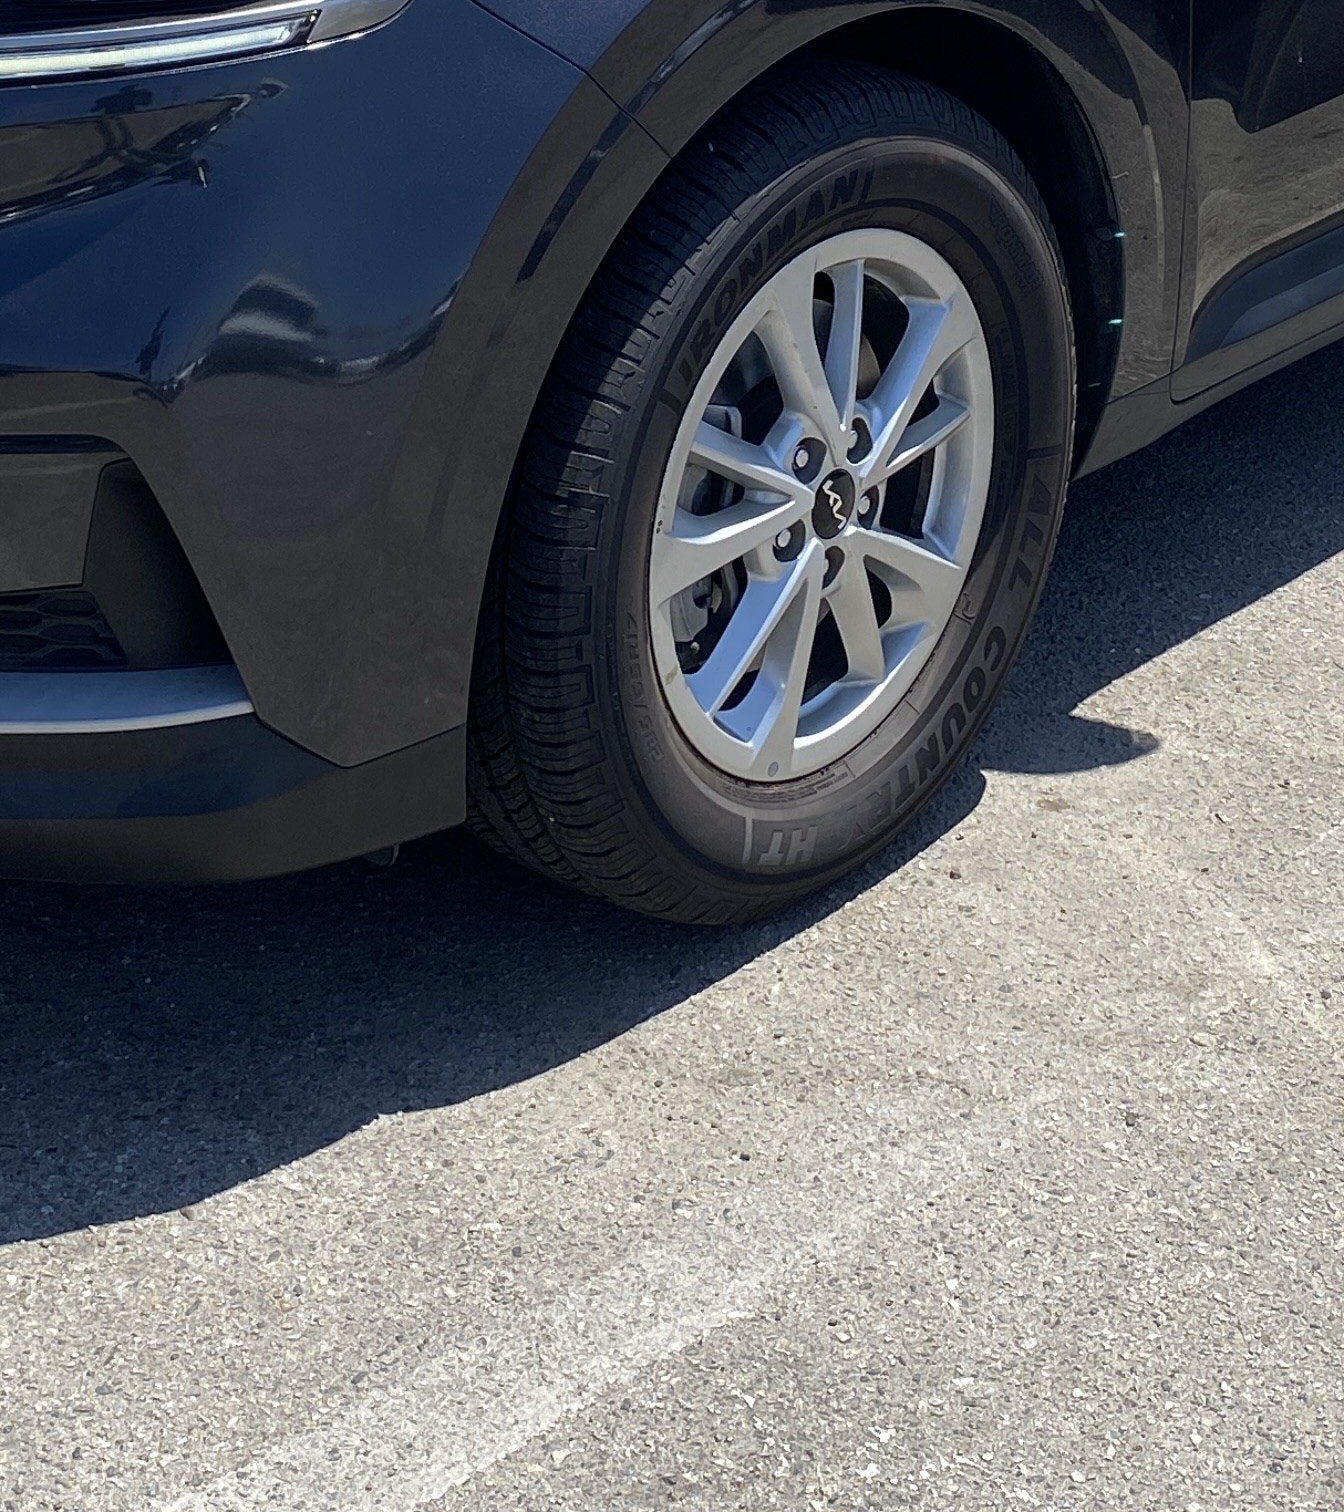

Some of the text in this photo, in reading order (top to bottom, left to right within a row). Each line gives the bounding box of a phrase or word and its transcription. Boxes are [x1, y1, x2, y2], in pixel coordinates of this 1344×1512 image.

[675, 168, 859, 384] IRONMAN
[759, 826, 818, 866] HT
[836, 626, 1006, 851] COUNTRY
